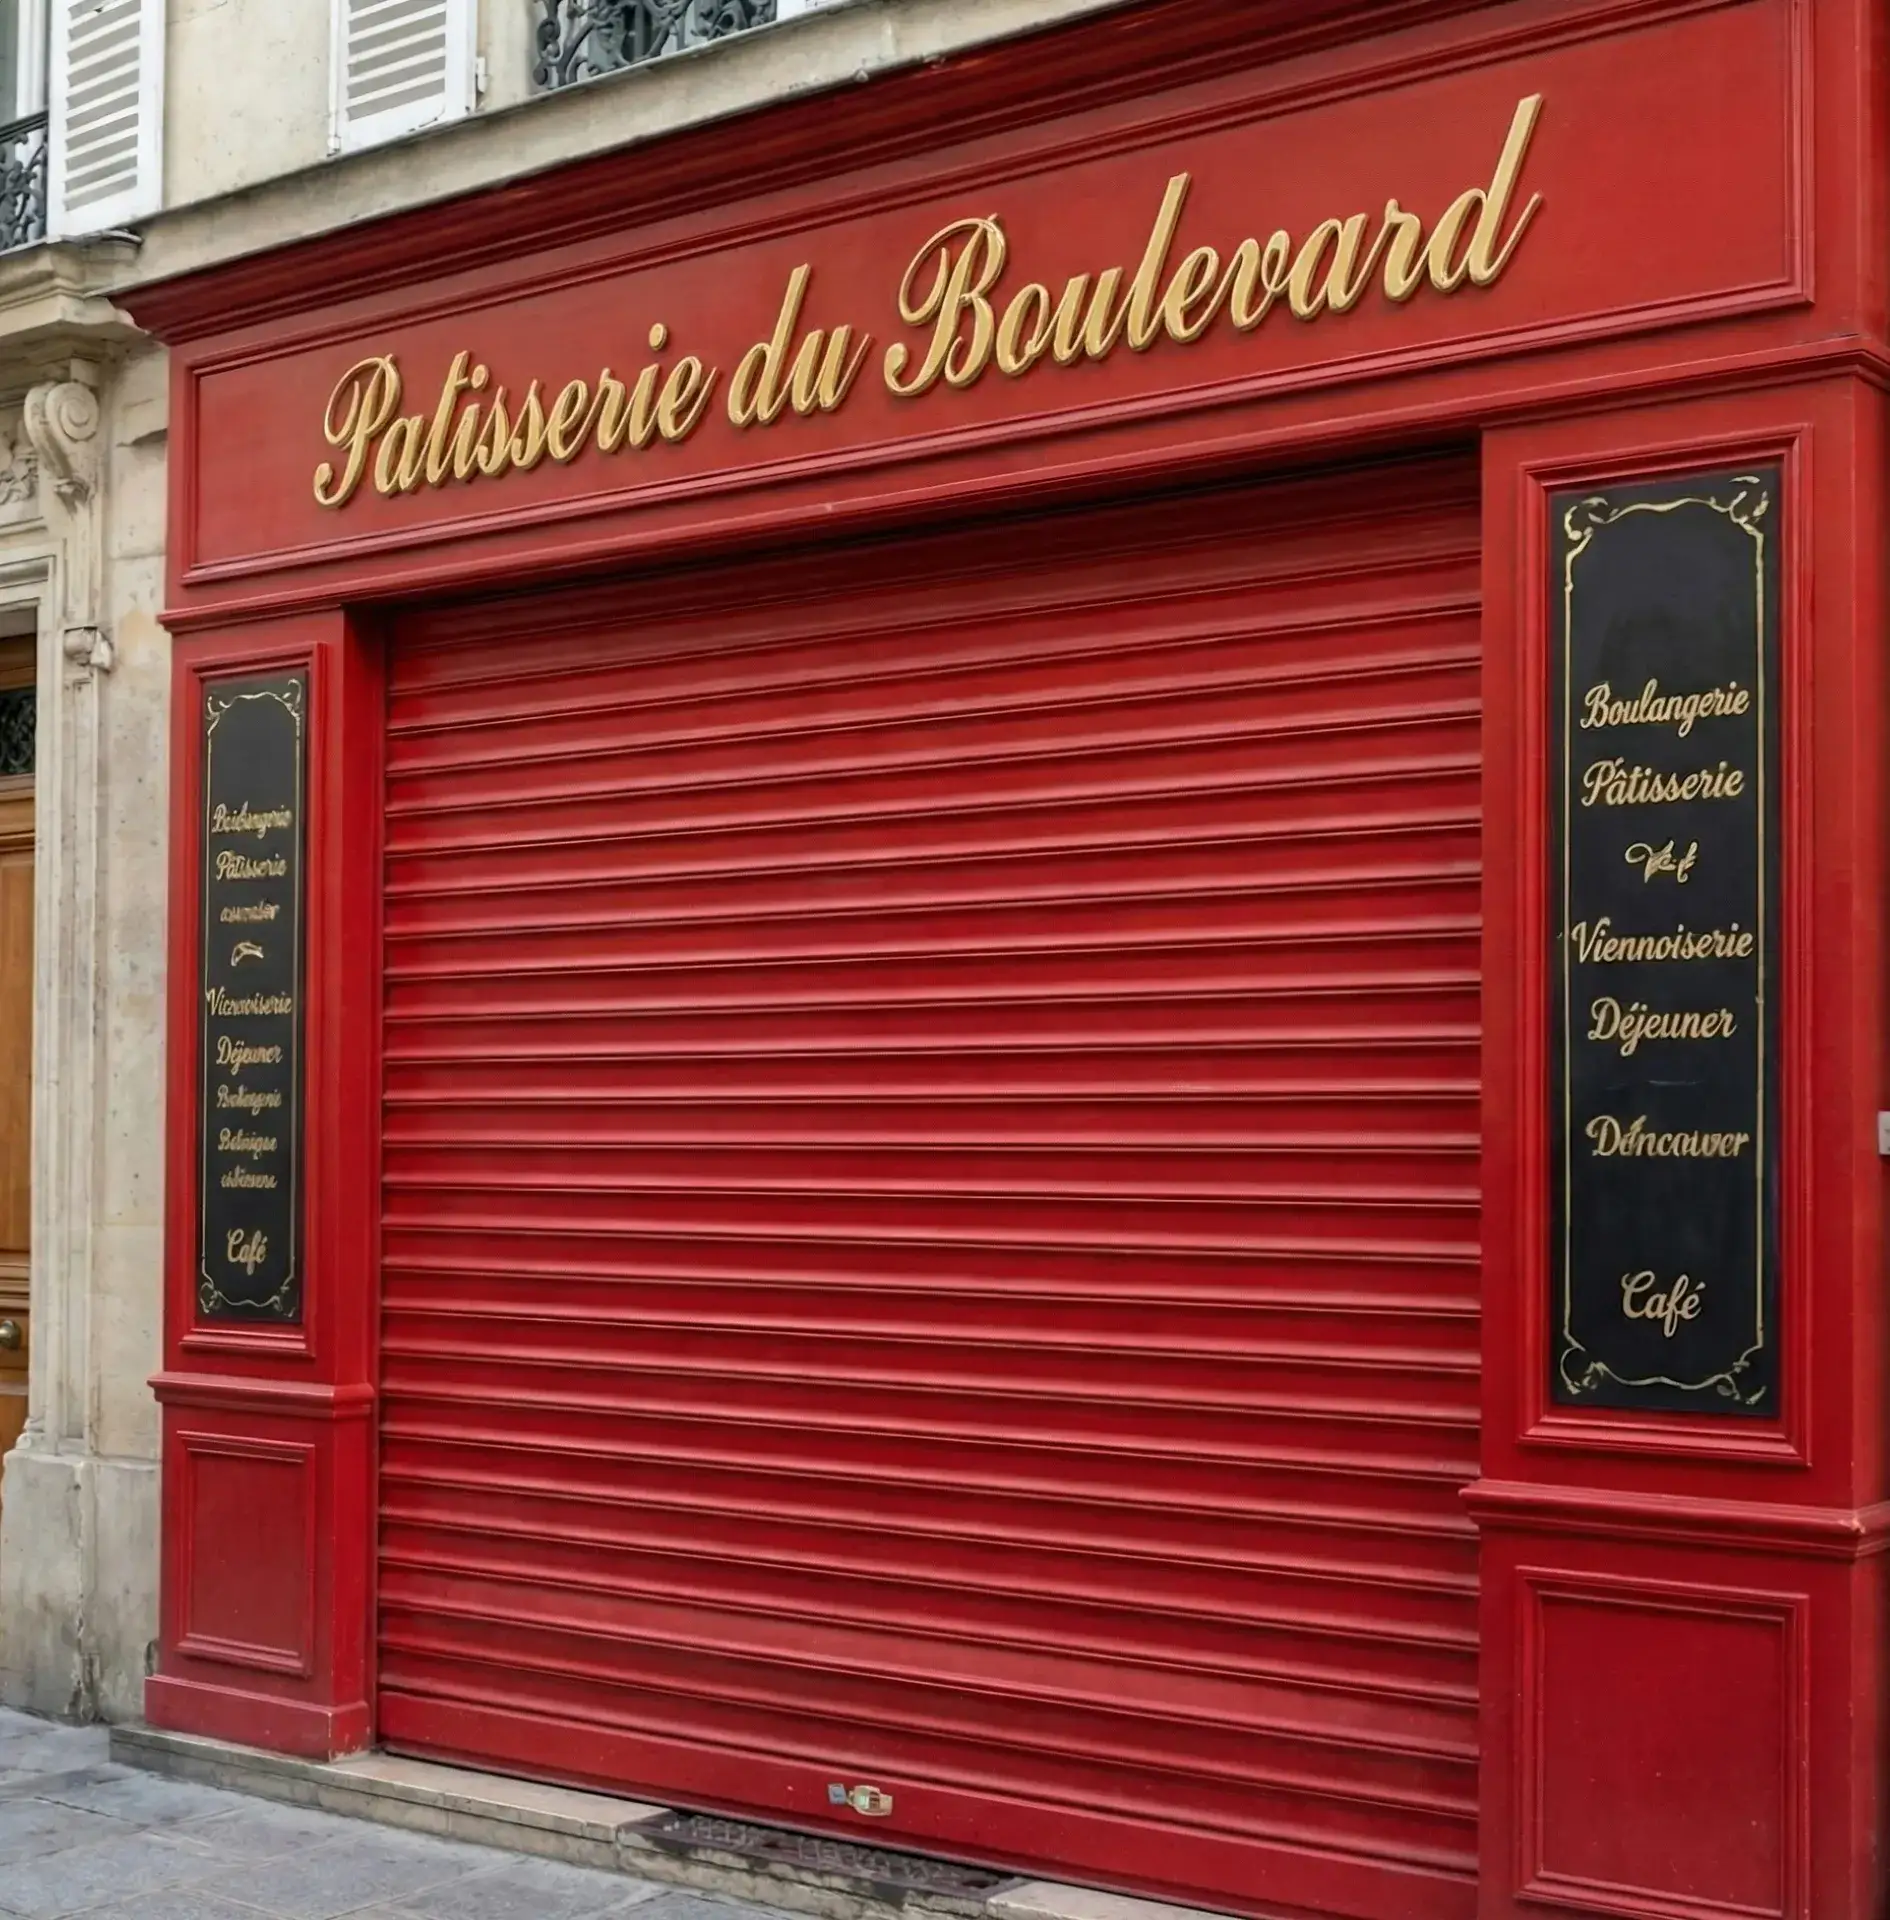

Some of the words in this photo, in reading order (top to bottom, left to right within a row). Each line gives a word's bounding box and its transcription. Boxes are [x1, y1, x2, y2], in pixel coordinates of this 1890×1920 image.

[314, 322, 717, 506] Patisserie
[727, 263, 870, 426] du
[884, 94, 1541, 399] Boulevard
[1579, 677, 1750, 738] Boulangerie
[1571, 916, 1755, 964] Viennoiserie
[1587, 996, 1738, 1057] Déjeuner
[226, 1228, 268, 1276] Café
[1620, 1270, 1706, 1338] Café
